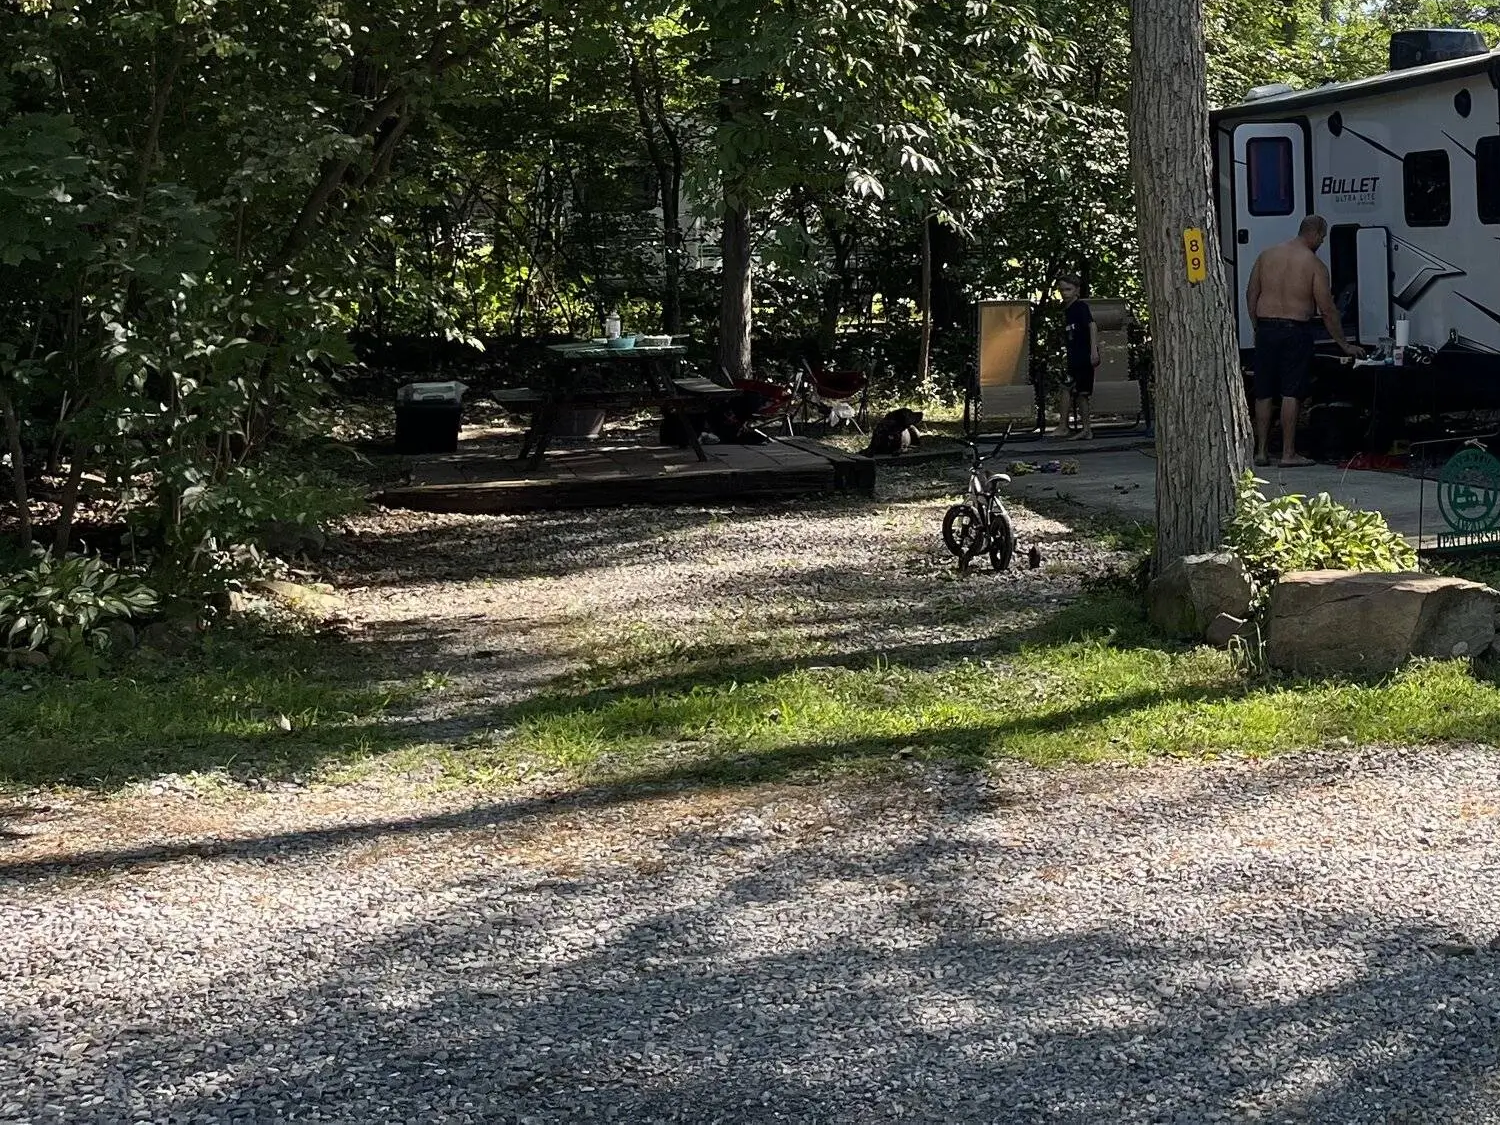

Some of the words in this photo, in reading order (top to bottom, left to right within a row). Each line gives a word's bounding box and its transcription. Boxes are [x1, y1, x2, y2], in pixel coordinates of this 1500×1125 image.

[1321, 176, 1380, 194] BULLET
[1335, 194, 1356, 203] ULTRA
[1360, 193, 1375, 202] LITE
